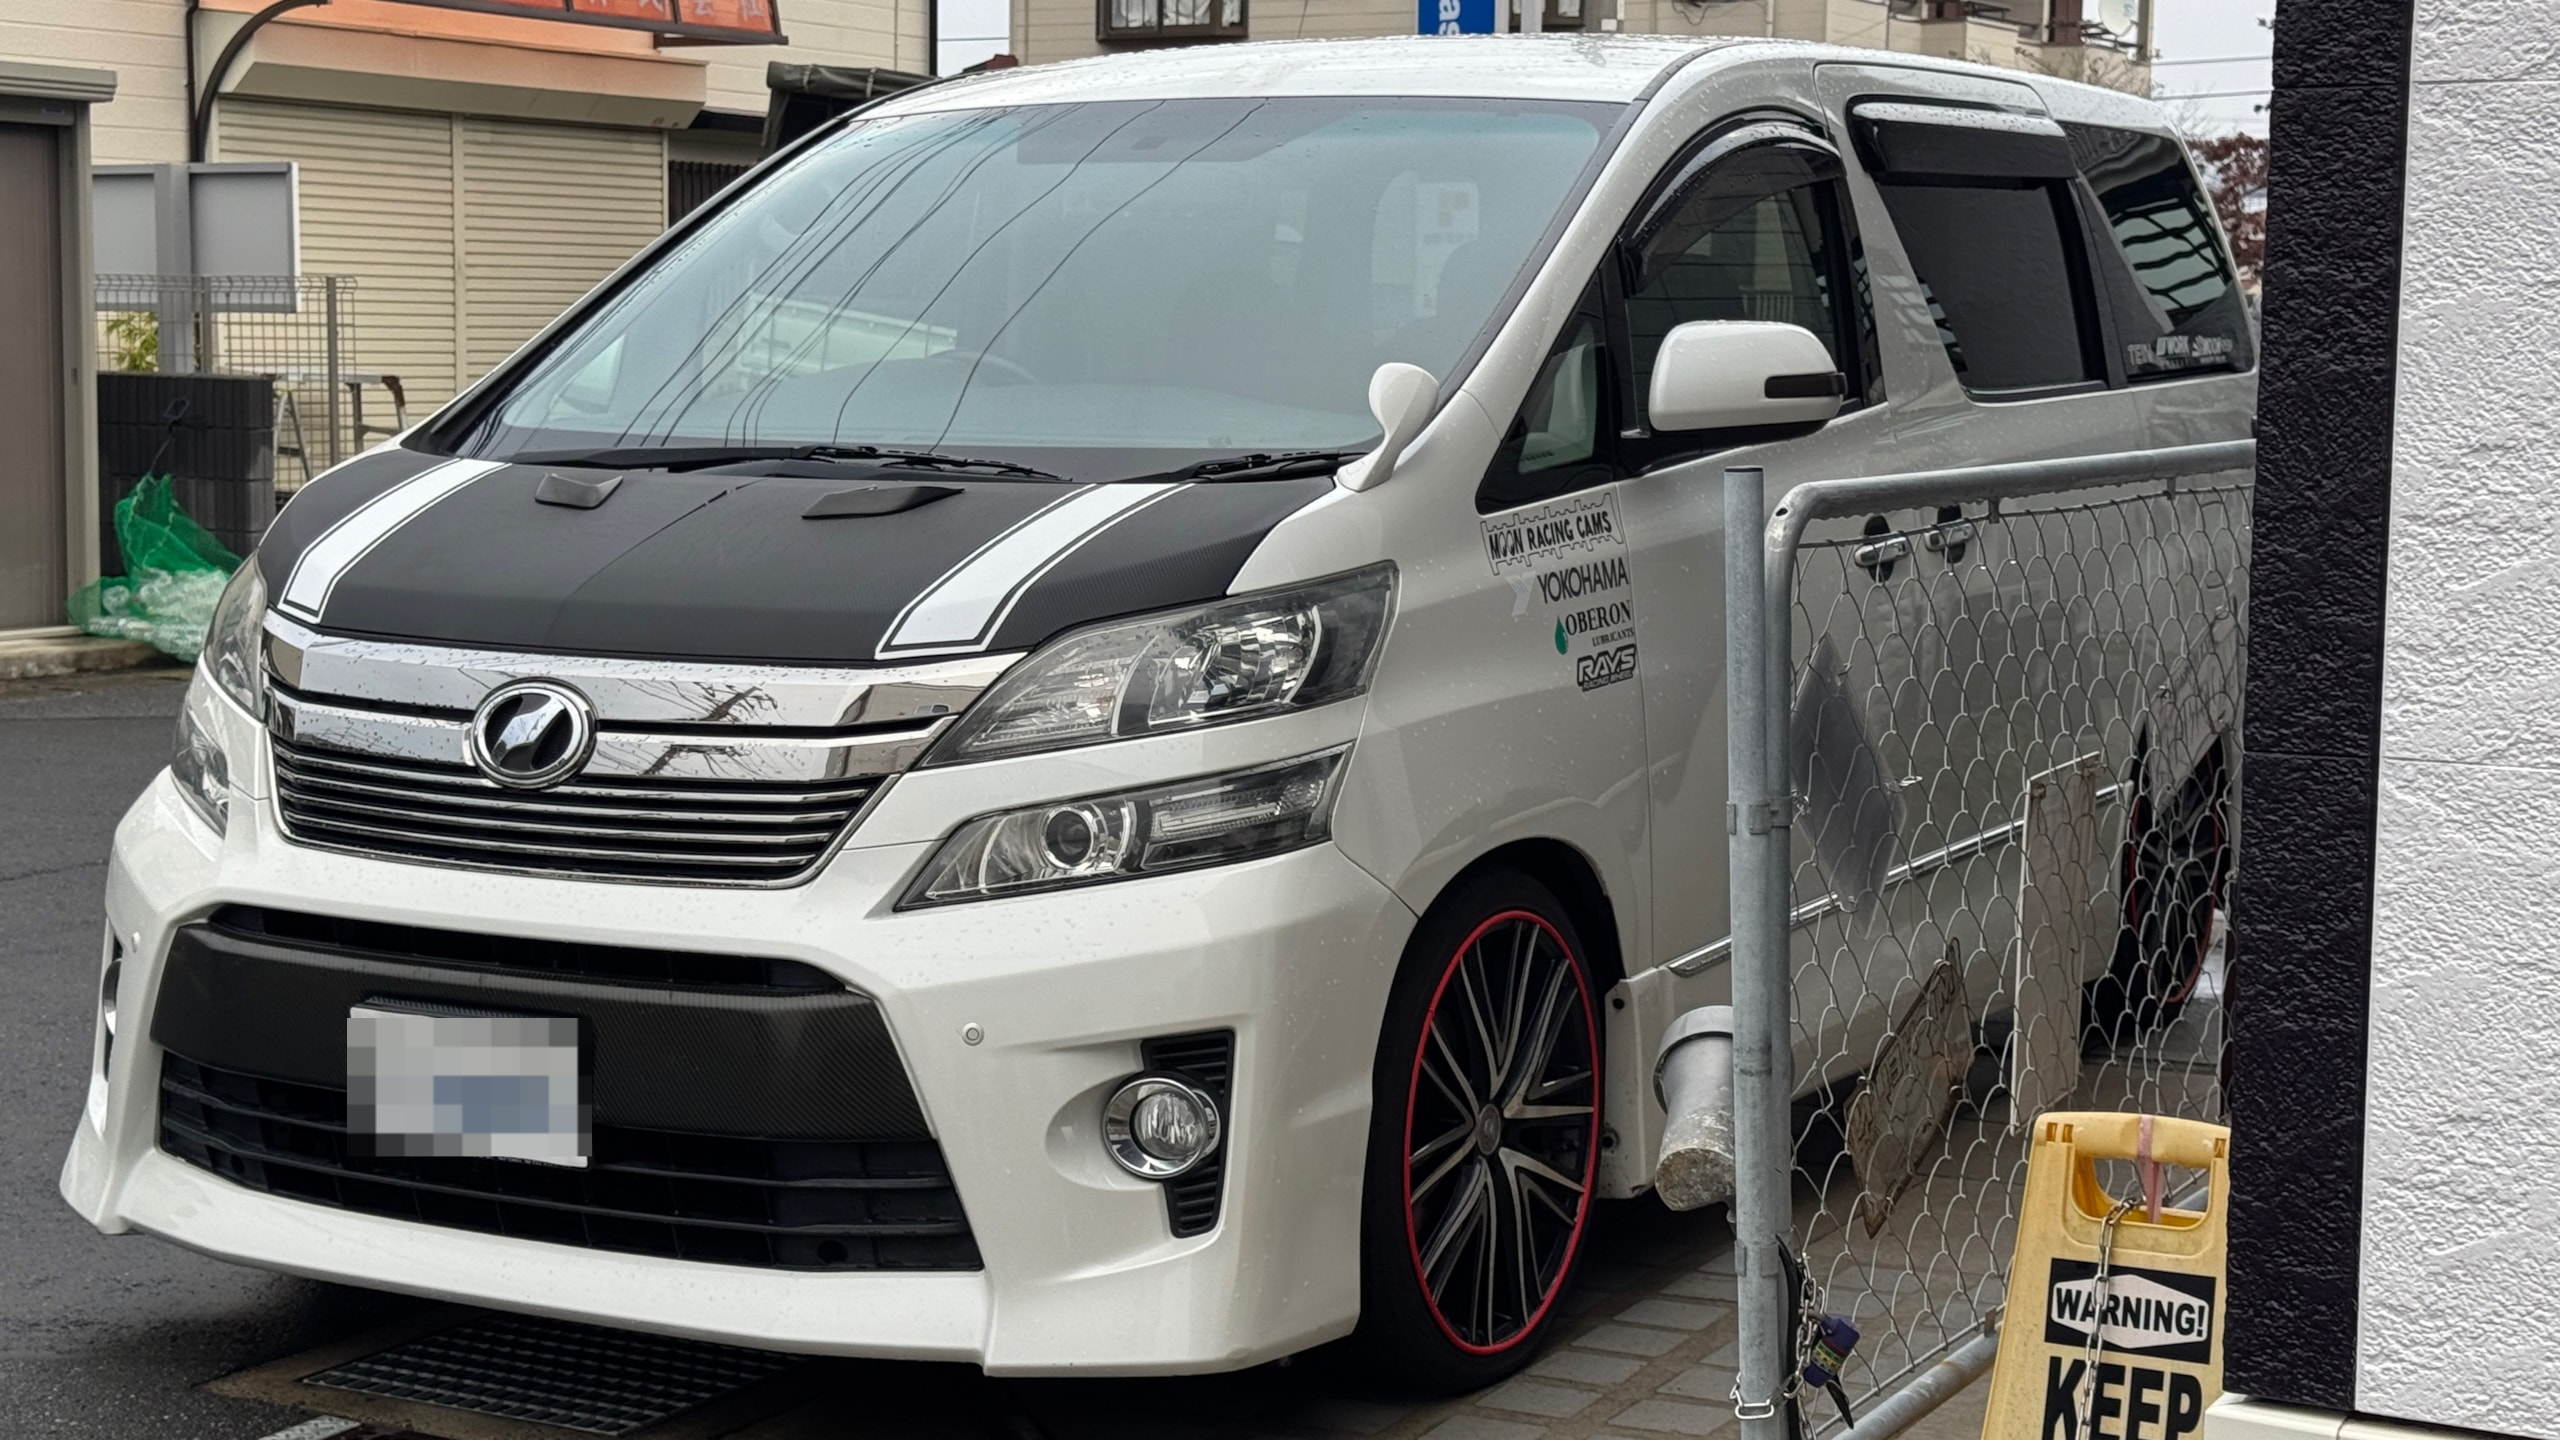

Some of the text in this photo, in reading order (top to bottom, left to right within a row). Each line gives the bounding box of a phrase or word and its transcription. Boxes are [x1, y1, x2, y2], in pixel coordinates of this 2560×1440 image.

[1489, 510, 1612, 560] MOON RACING CAMS
[1537, 556, 1630, 604] YOKOHAMA
[1565, 600, 1632, 636] OBERON
[1592, 627, 1635, 647] LUBRICANTS
[1577, 643, 1637, 687] RAYS
[2055, 1287, 2206, 1338] WARNING!
[2041, 1356, 2203, 1440] KEEP
